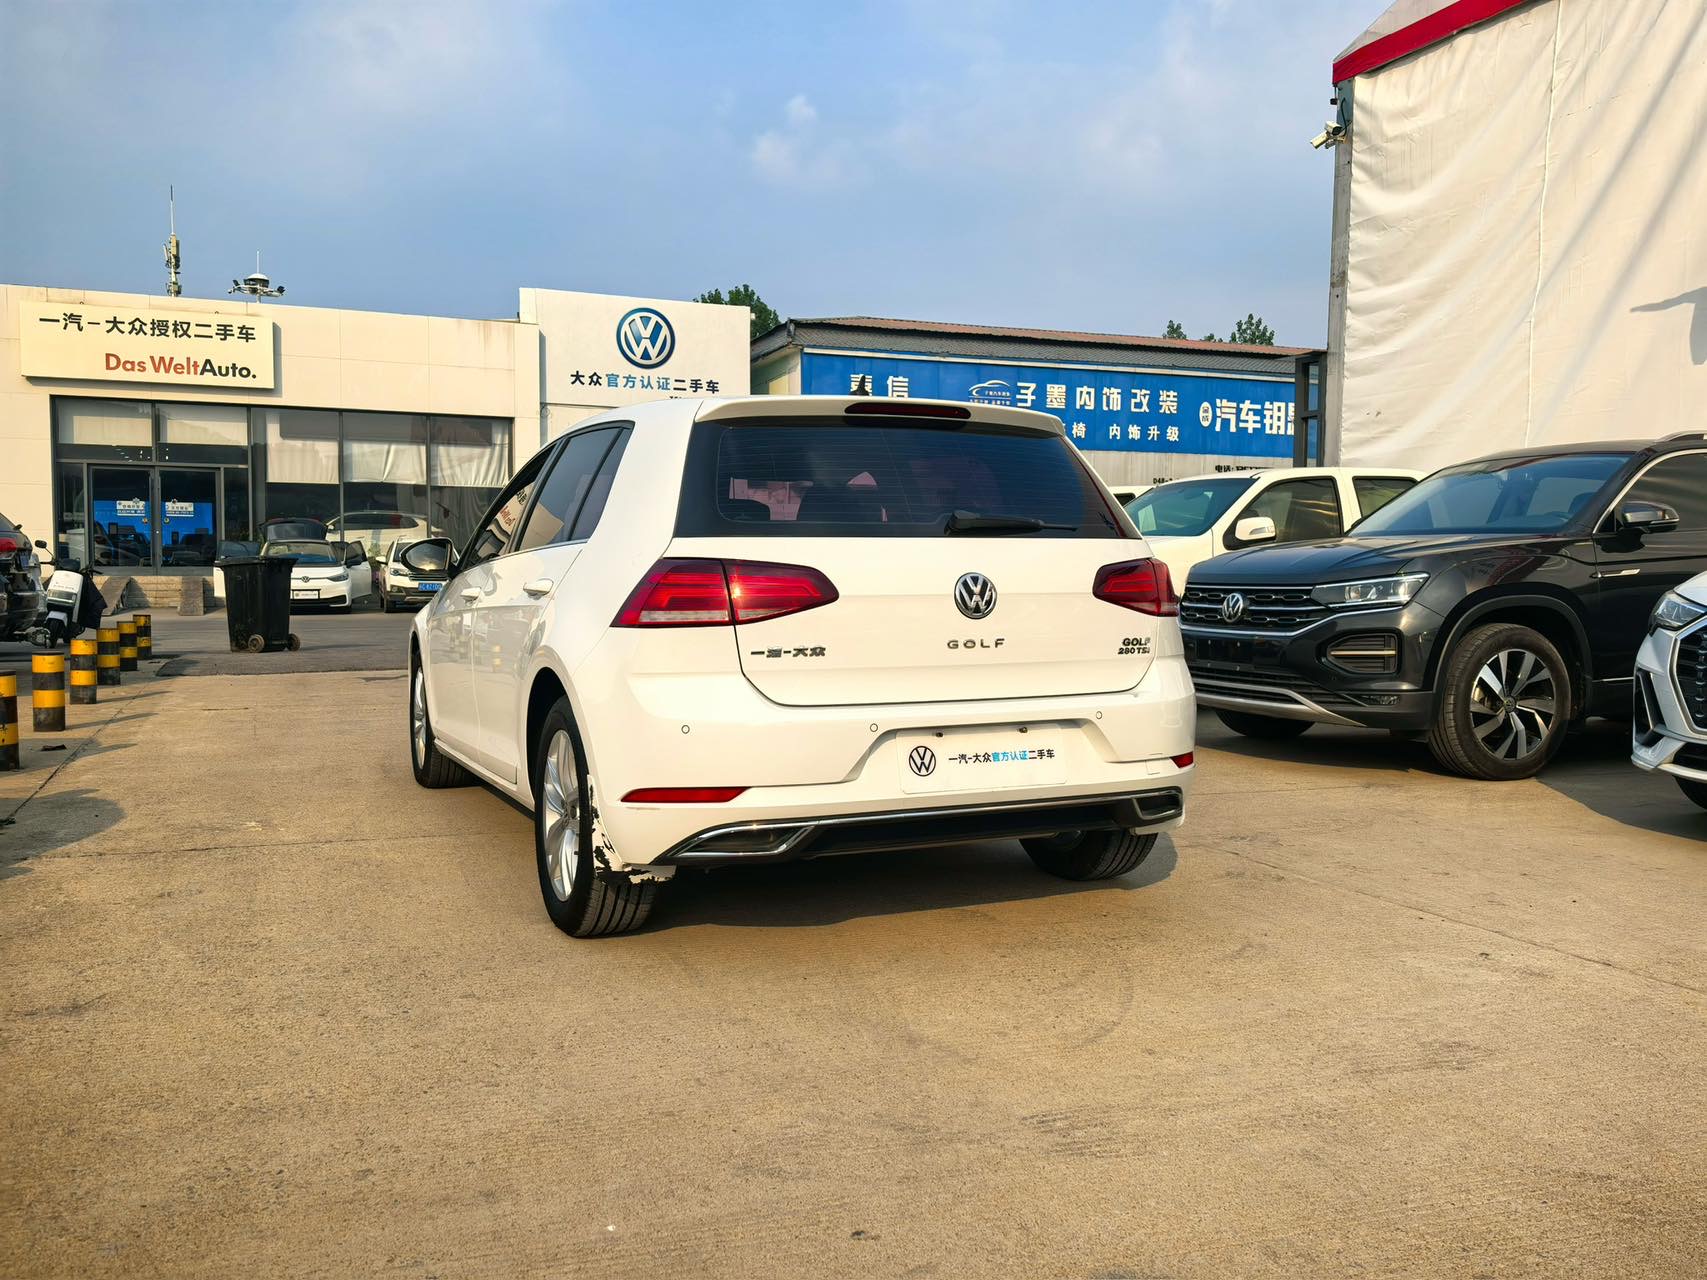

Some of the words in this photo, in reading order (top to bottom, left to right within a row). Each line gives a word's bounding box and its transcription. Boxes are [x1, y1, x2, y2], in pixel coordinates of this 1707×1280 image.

[105, 353, 147, 372] Das
[570, 370, 720, 394] 大众官方认证二手车
[1015, 381, 1178, 414] 子墨内饰改装
[1109, 423, 1180, 442] 内饰升级
[947, 638, 1005, 650] GOLF
[1122, 637, 1151, 647] GOLF
